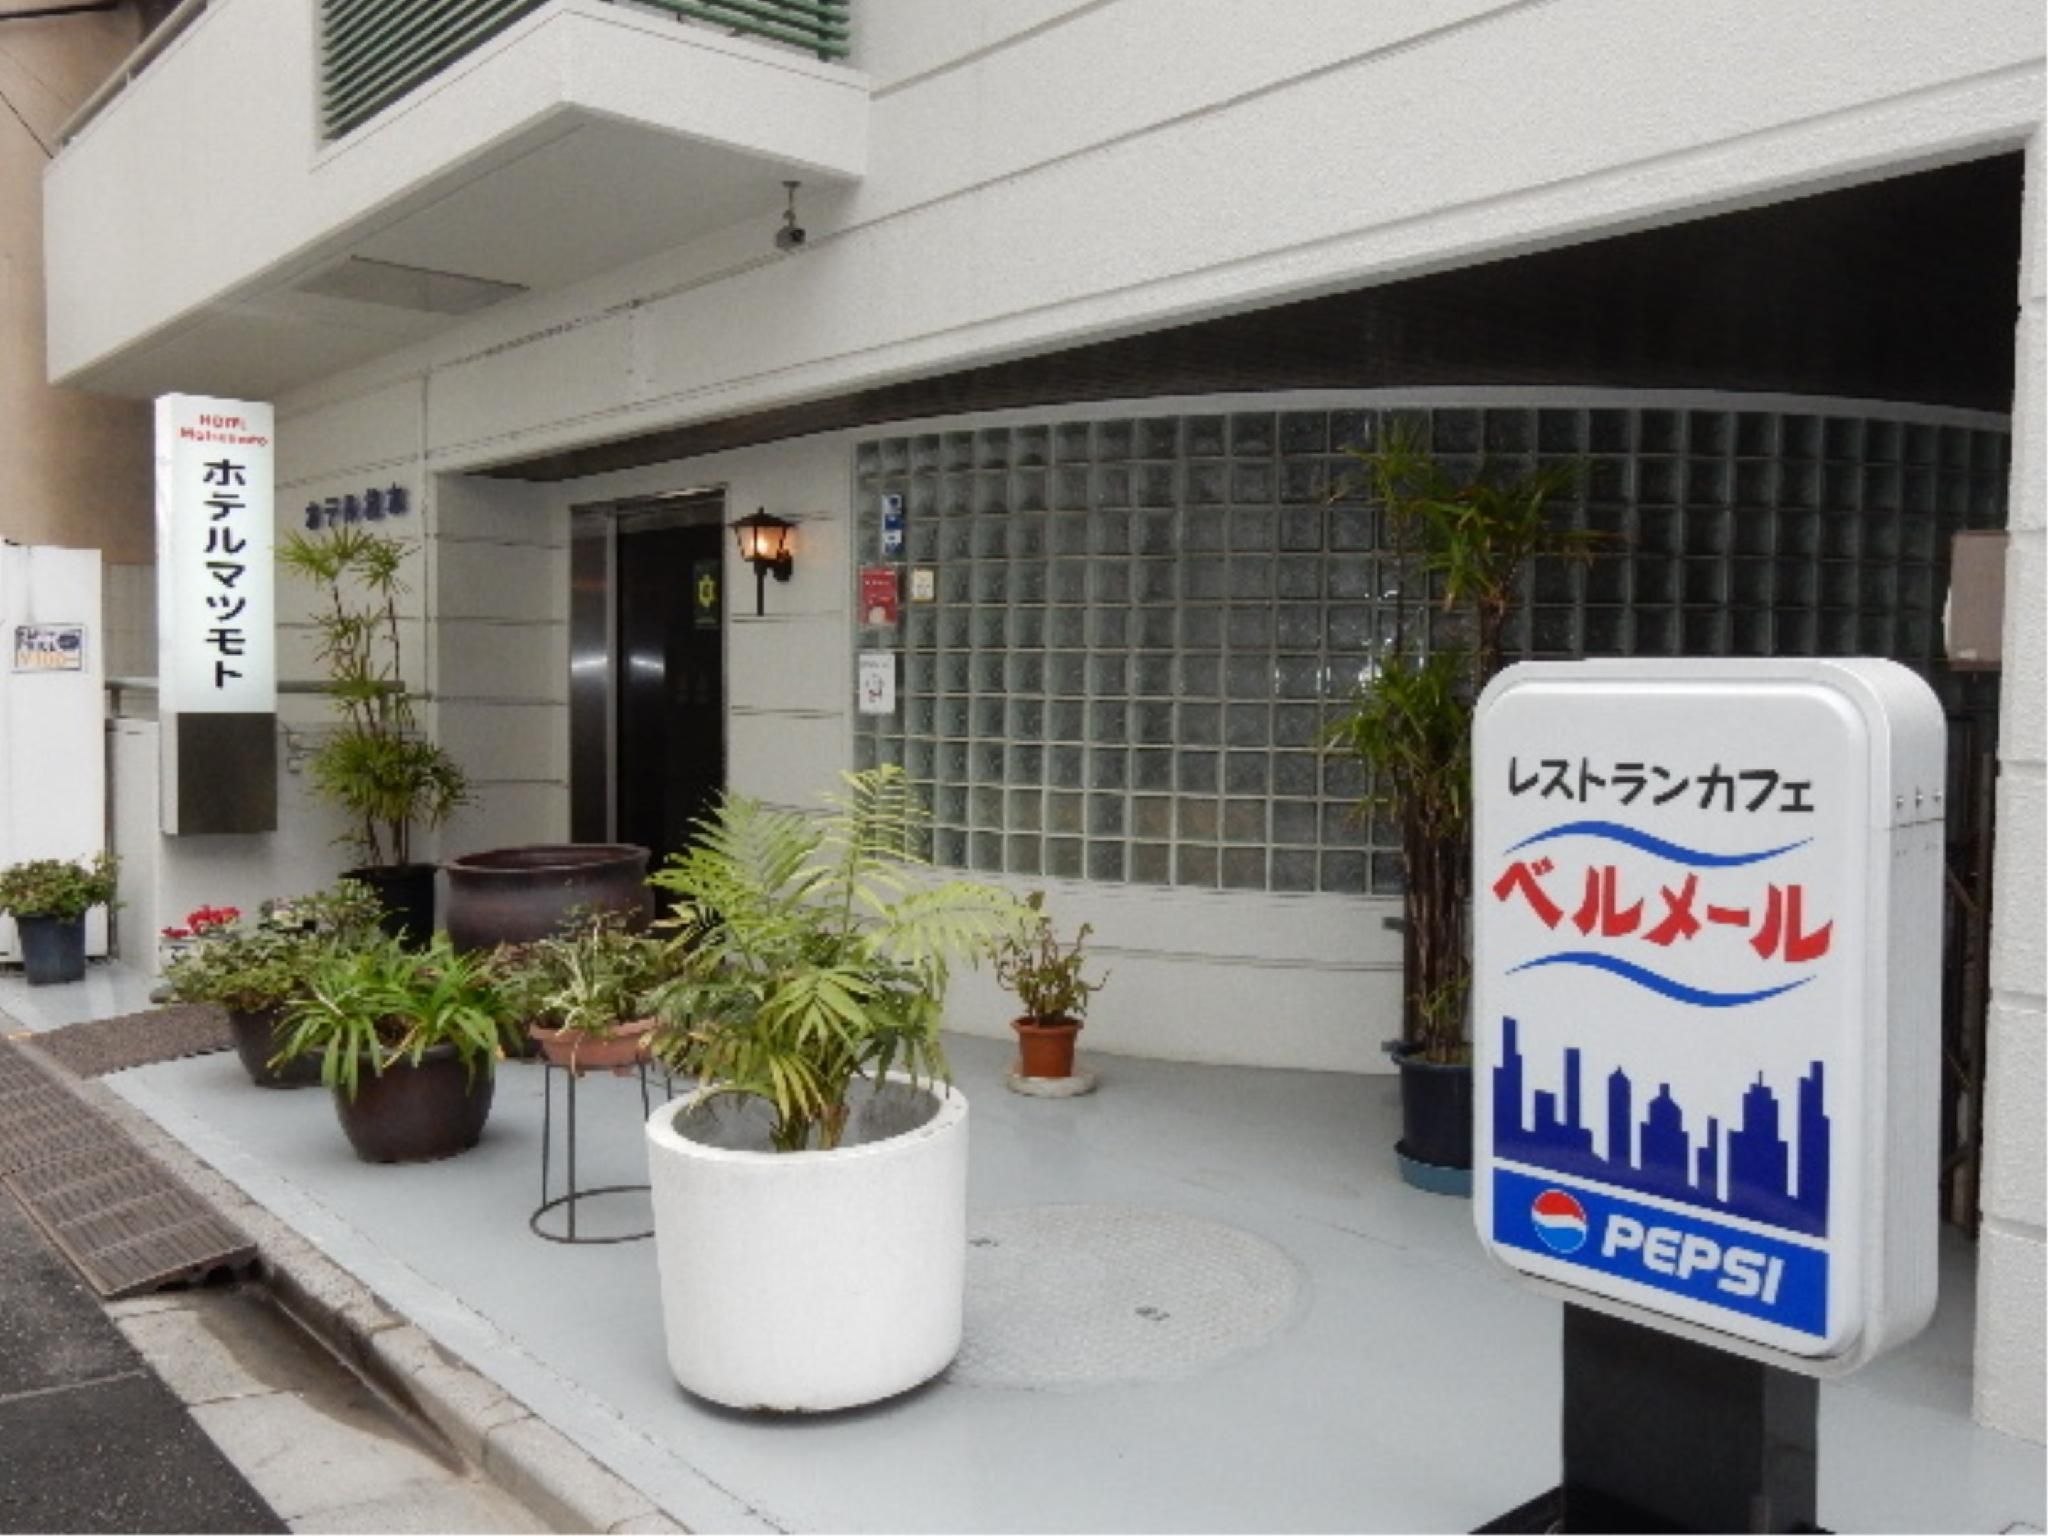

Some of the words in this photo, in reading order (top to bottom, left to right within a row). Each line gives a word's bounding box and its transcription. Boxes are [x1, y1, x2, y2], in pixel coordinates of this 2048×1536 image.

[203, 458, 247, 690] ホテルマツモト
[1493, 858, 1834, 962] ベルメール
[1601, 1214, 1785, 1305] PEPSI
